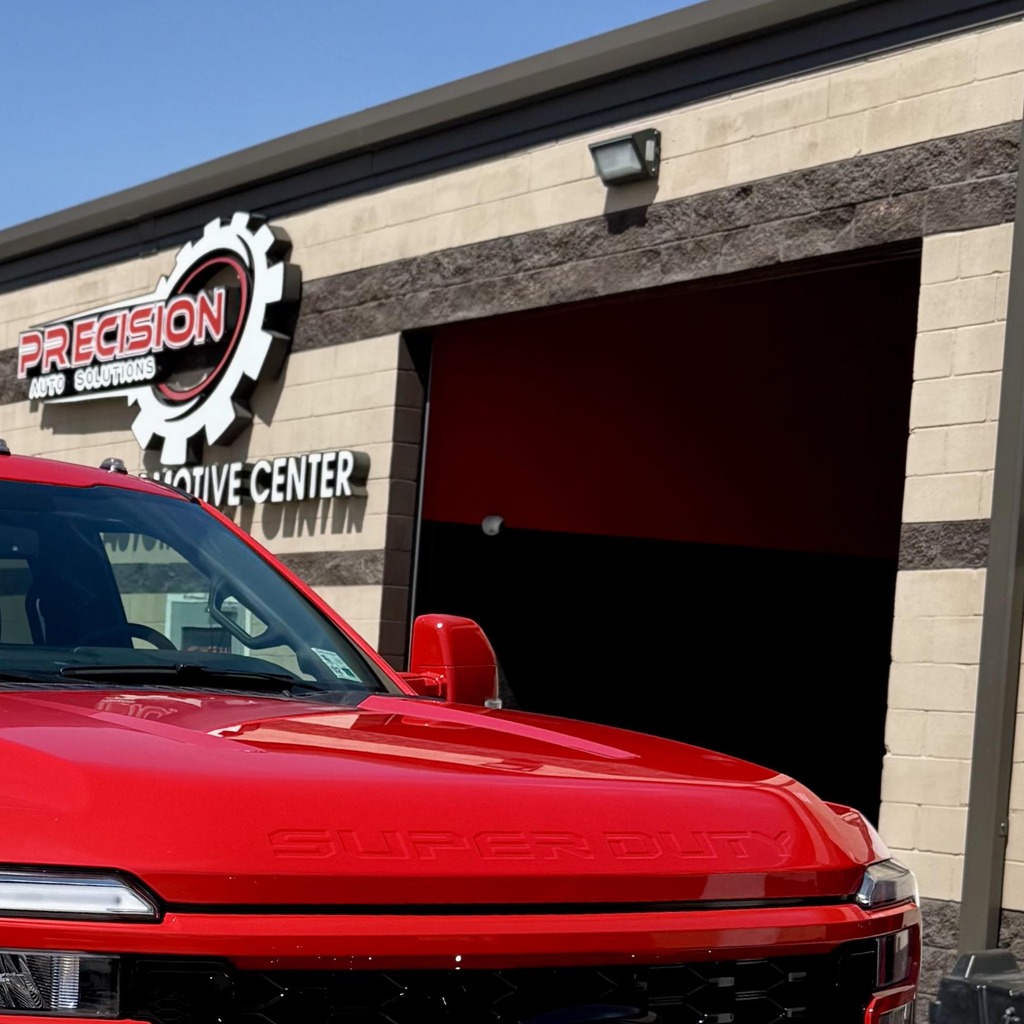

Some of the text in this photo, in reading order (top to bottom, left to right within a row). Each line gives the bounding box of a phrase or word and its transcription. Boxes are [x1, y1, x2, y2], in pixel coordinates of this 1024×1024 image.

[17, 288, 225, 379] PRECISION
[29, 356, 156, 399] AUTO SOLUTIONS
[250, 451, 354, 503] CENTER
[268, 828, 794, 860] SUPER DUTY
